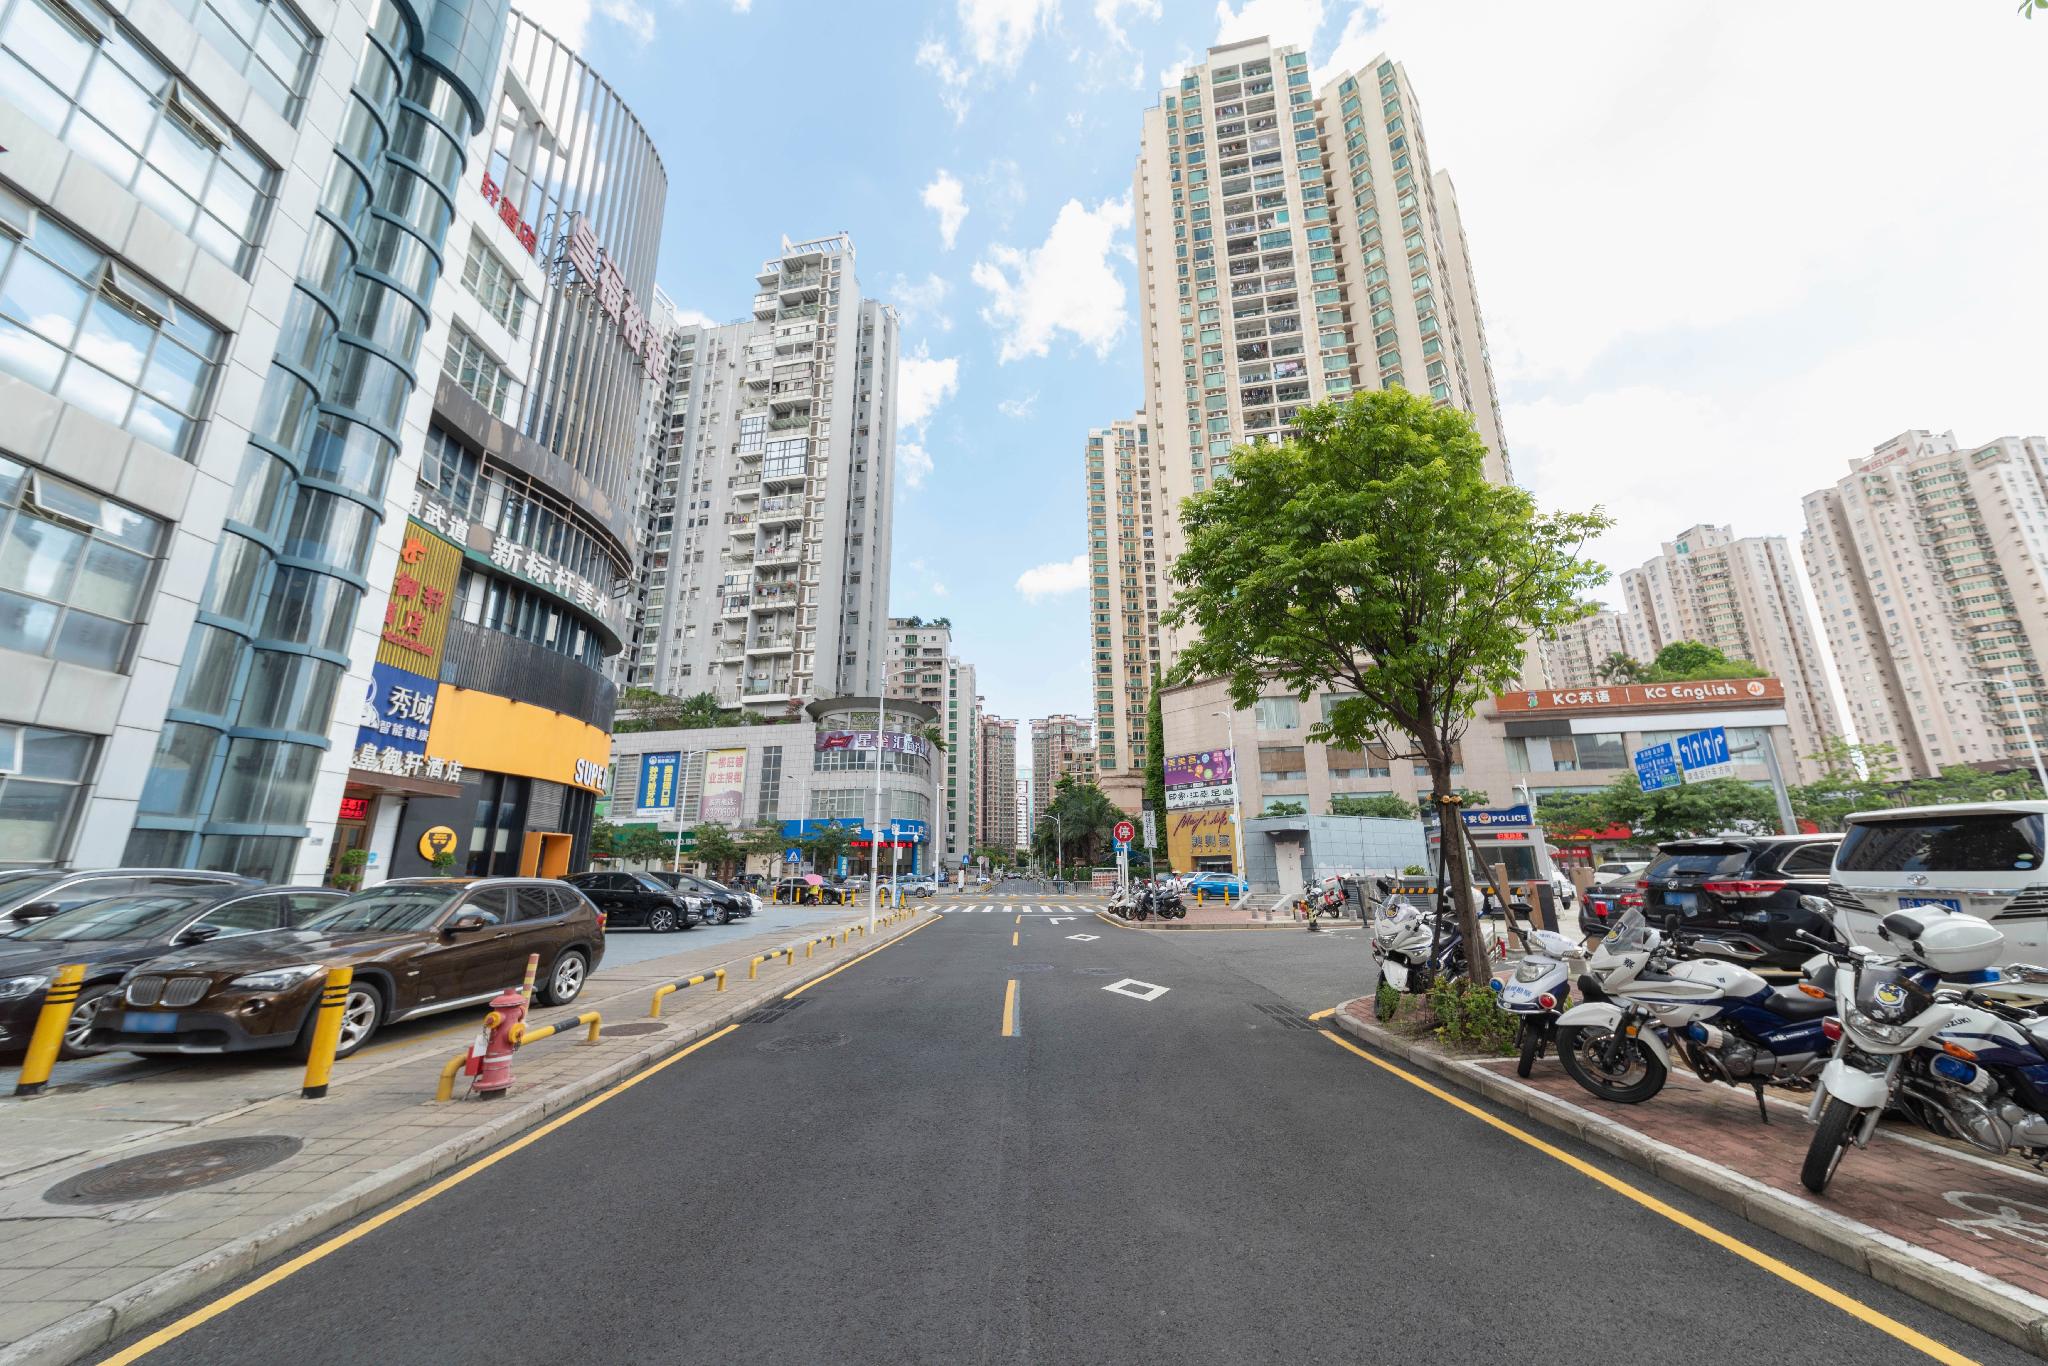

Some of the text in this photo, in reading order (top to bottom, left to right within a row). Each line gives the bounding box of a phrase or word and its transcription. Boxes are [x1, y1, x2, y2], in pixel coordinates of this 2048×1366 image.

[490, 536, 608, 619] 新标杆美术
[1552, 690, 1611, 706] KC英语
[1645, 687, 1667, 699] KC
[1672, 682, 1737, 700] English
[387, 685, 434, 725] 秀域
[378, 719, 430, 743] 智能健康
[355, 742, 464, 783] 皇御轩酒店
[1492, 814, 1528, 822] POLICE
